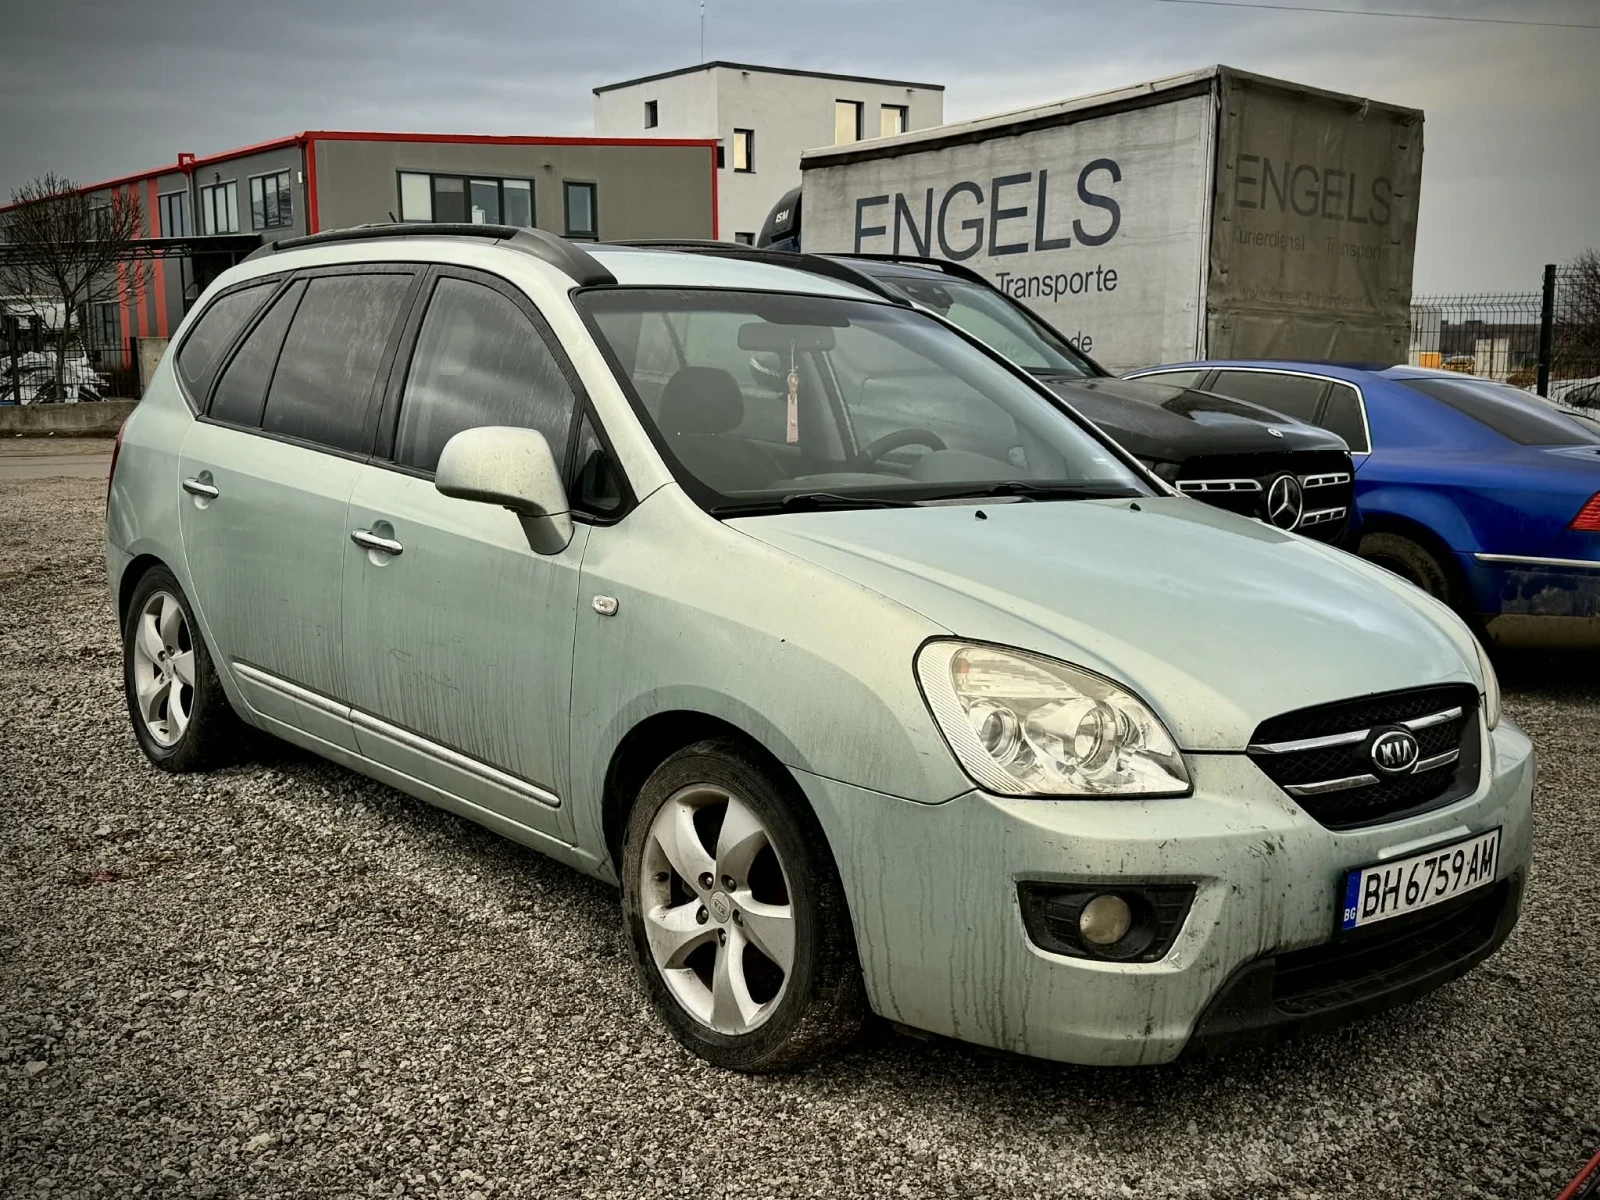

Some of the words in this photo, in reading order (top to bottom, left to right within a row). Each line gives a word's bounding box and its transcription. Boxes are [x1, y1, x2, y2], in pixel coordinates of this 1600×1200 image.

[1234, 153, 1392, 227] ENGELS
[775, 210, 789, 223] ISM
[855, 158, 1121, 261] ENGELS
[995, 264, 1118, 303] Transporte
[1380, 739, 1414, 765] KIA
[1344, 906, 1356, 921] BG
